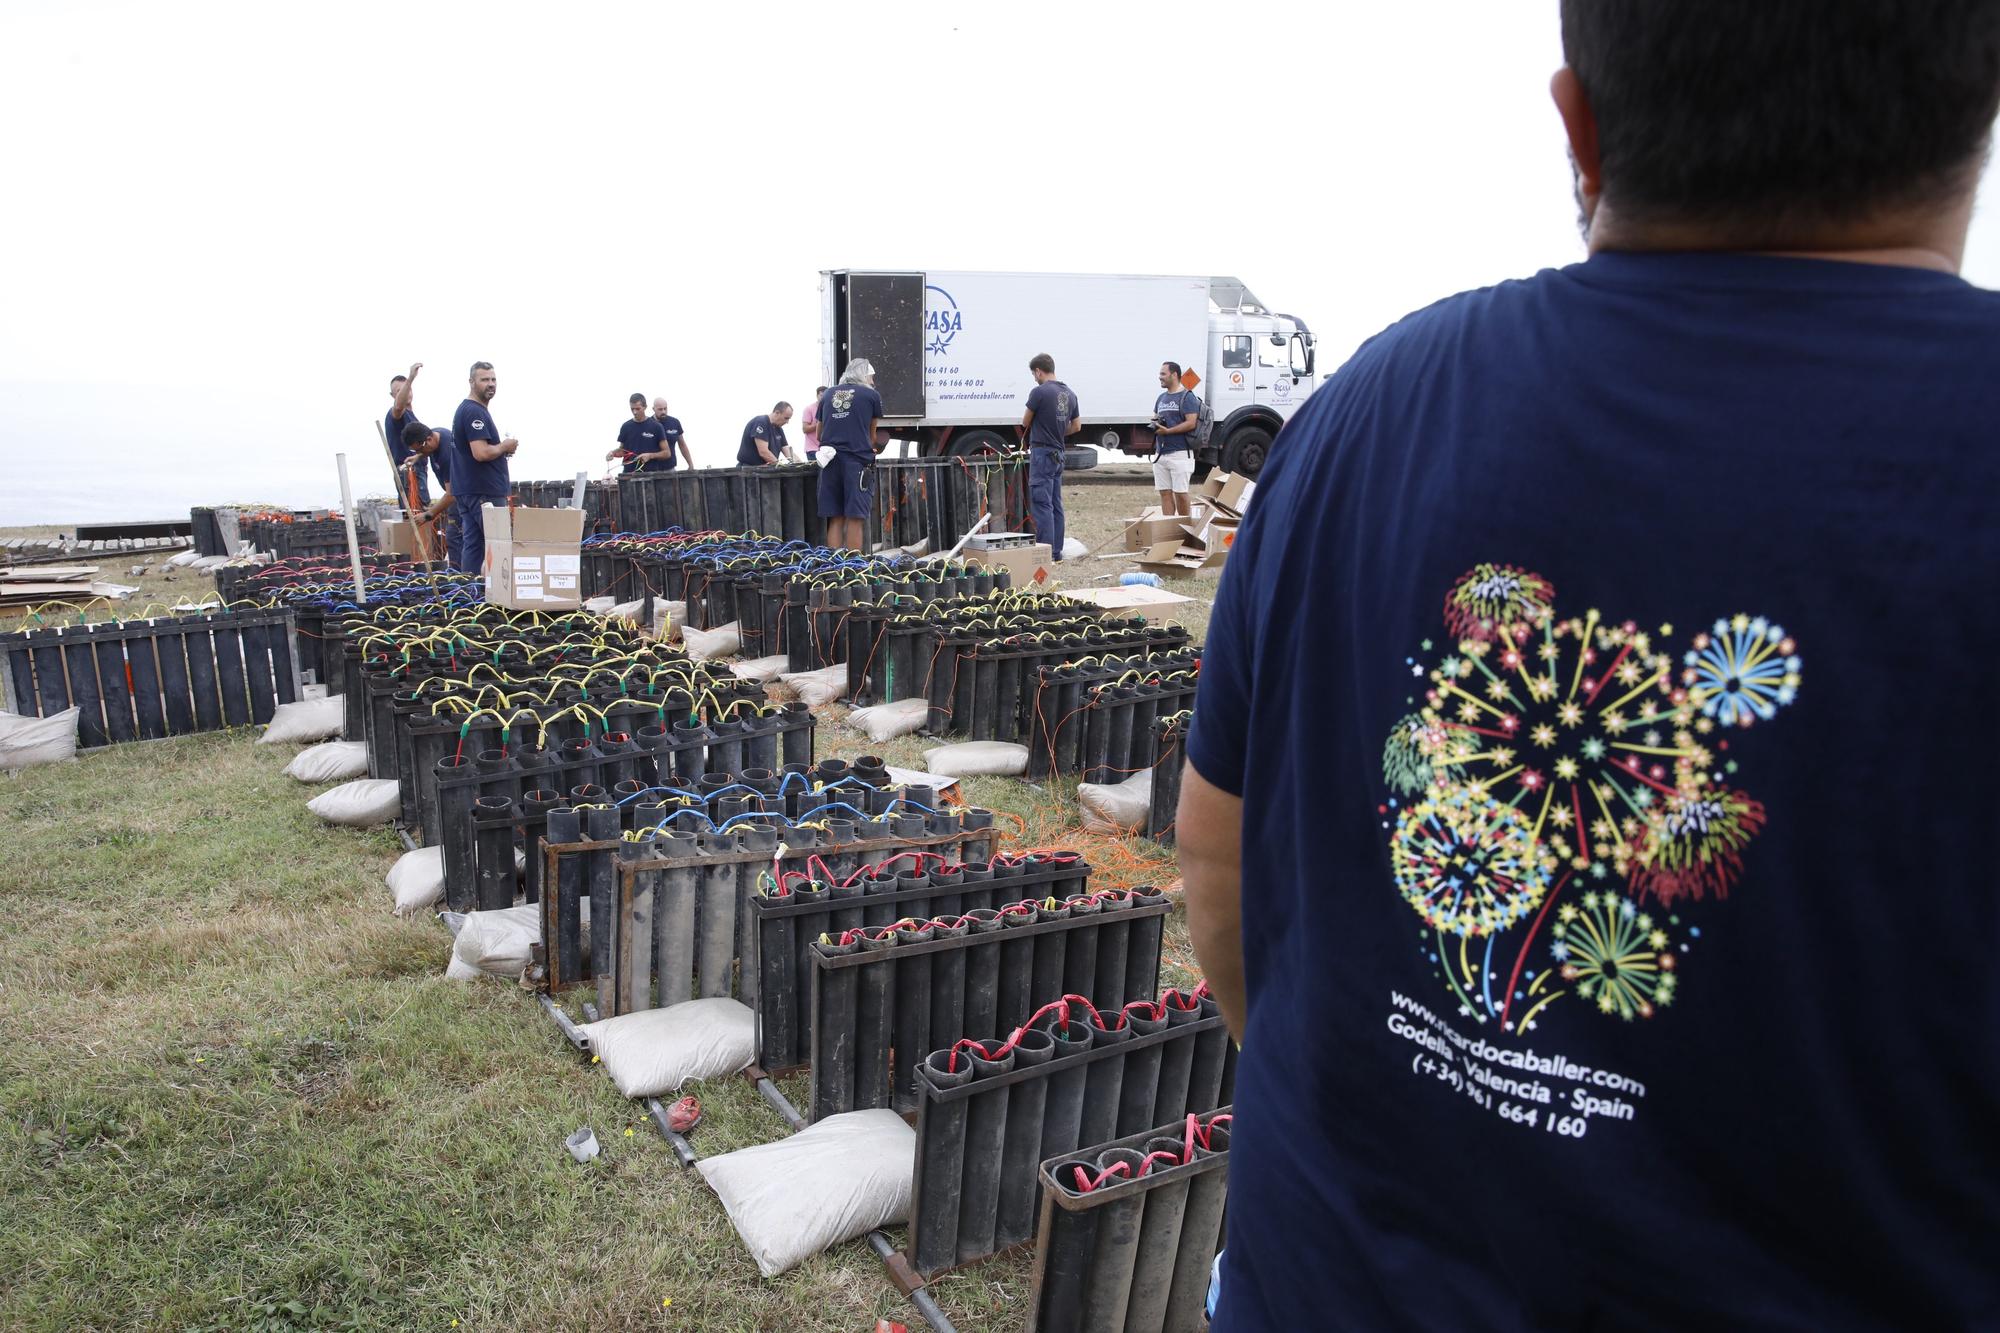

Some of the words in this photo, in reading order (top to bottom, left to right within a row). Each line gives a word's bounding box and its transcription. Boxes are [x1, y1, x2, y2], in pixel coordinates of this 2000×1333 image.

[925, 310, 962, 334] ASA
[938, 366, 948, 374] 41
[949, 366, 959, 374] 60
[938, 379, 948, 387] 96
[950, 379, 963, 387] 166
[964, 379, 974, 387] 40
[975, 379, 985, 387] 02
[939, 392, 1015, 400] www.ricardocaballer.com
[1387, 1013, 1454, 1061] Godella
[1463, 1056, 1551, 1104] Valencia
[1571, 1088, 1635, 1121] Spain
[1412, 1052, 1464, 1093] (+34)
[1466, 1081, 1493, 1110] 961
[1498, 1101, 1539, 1128] 664
[1546, 1112, 1587, 1138] 160
